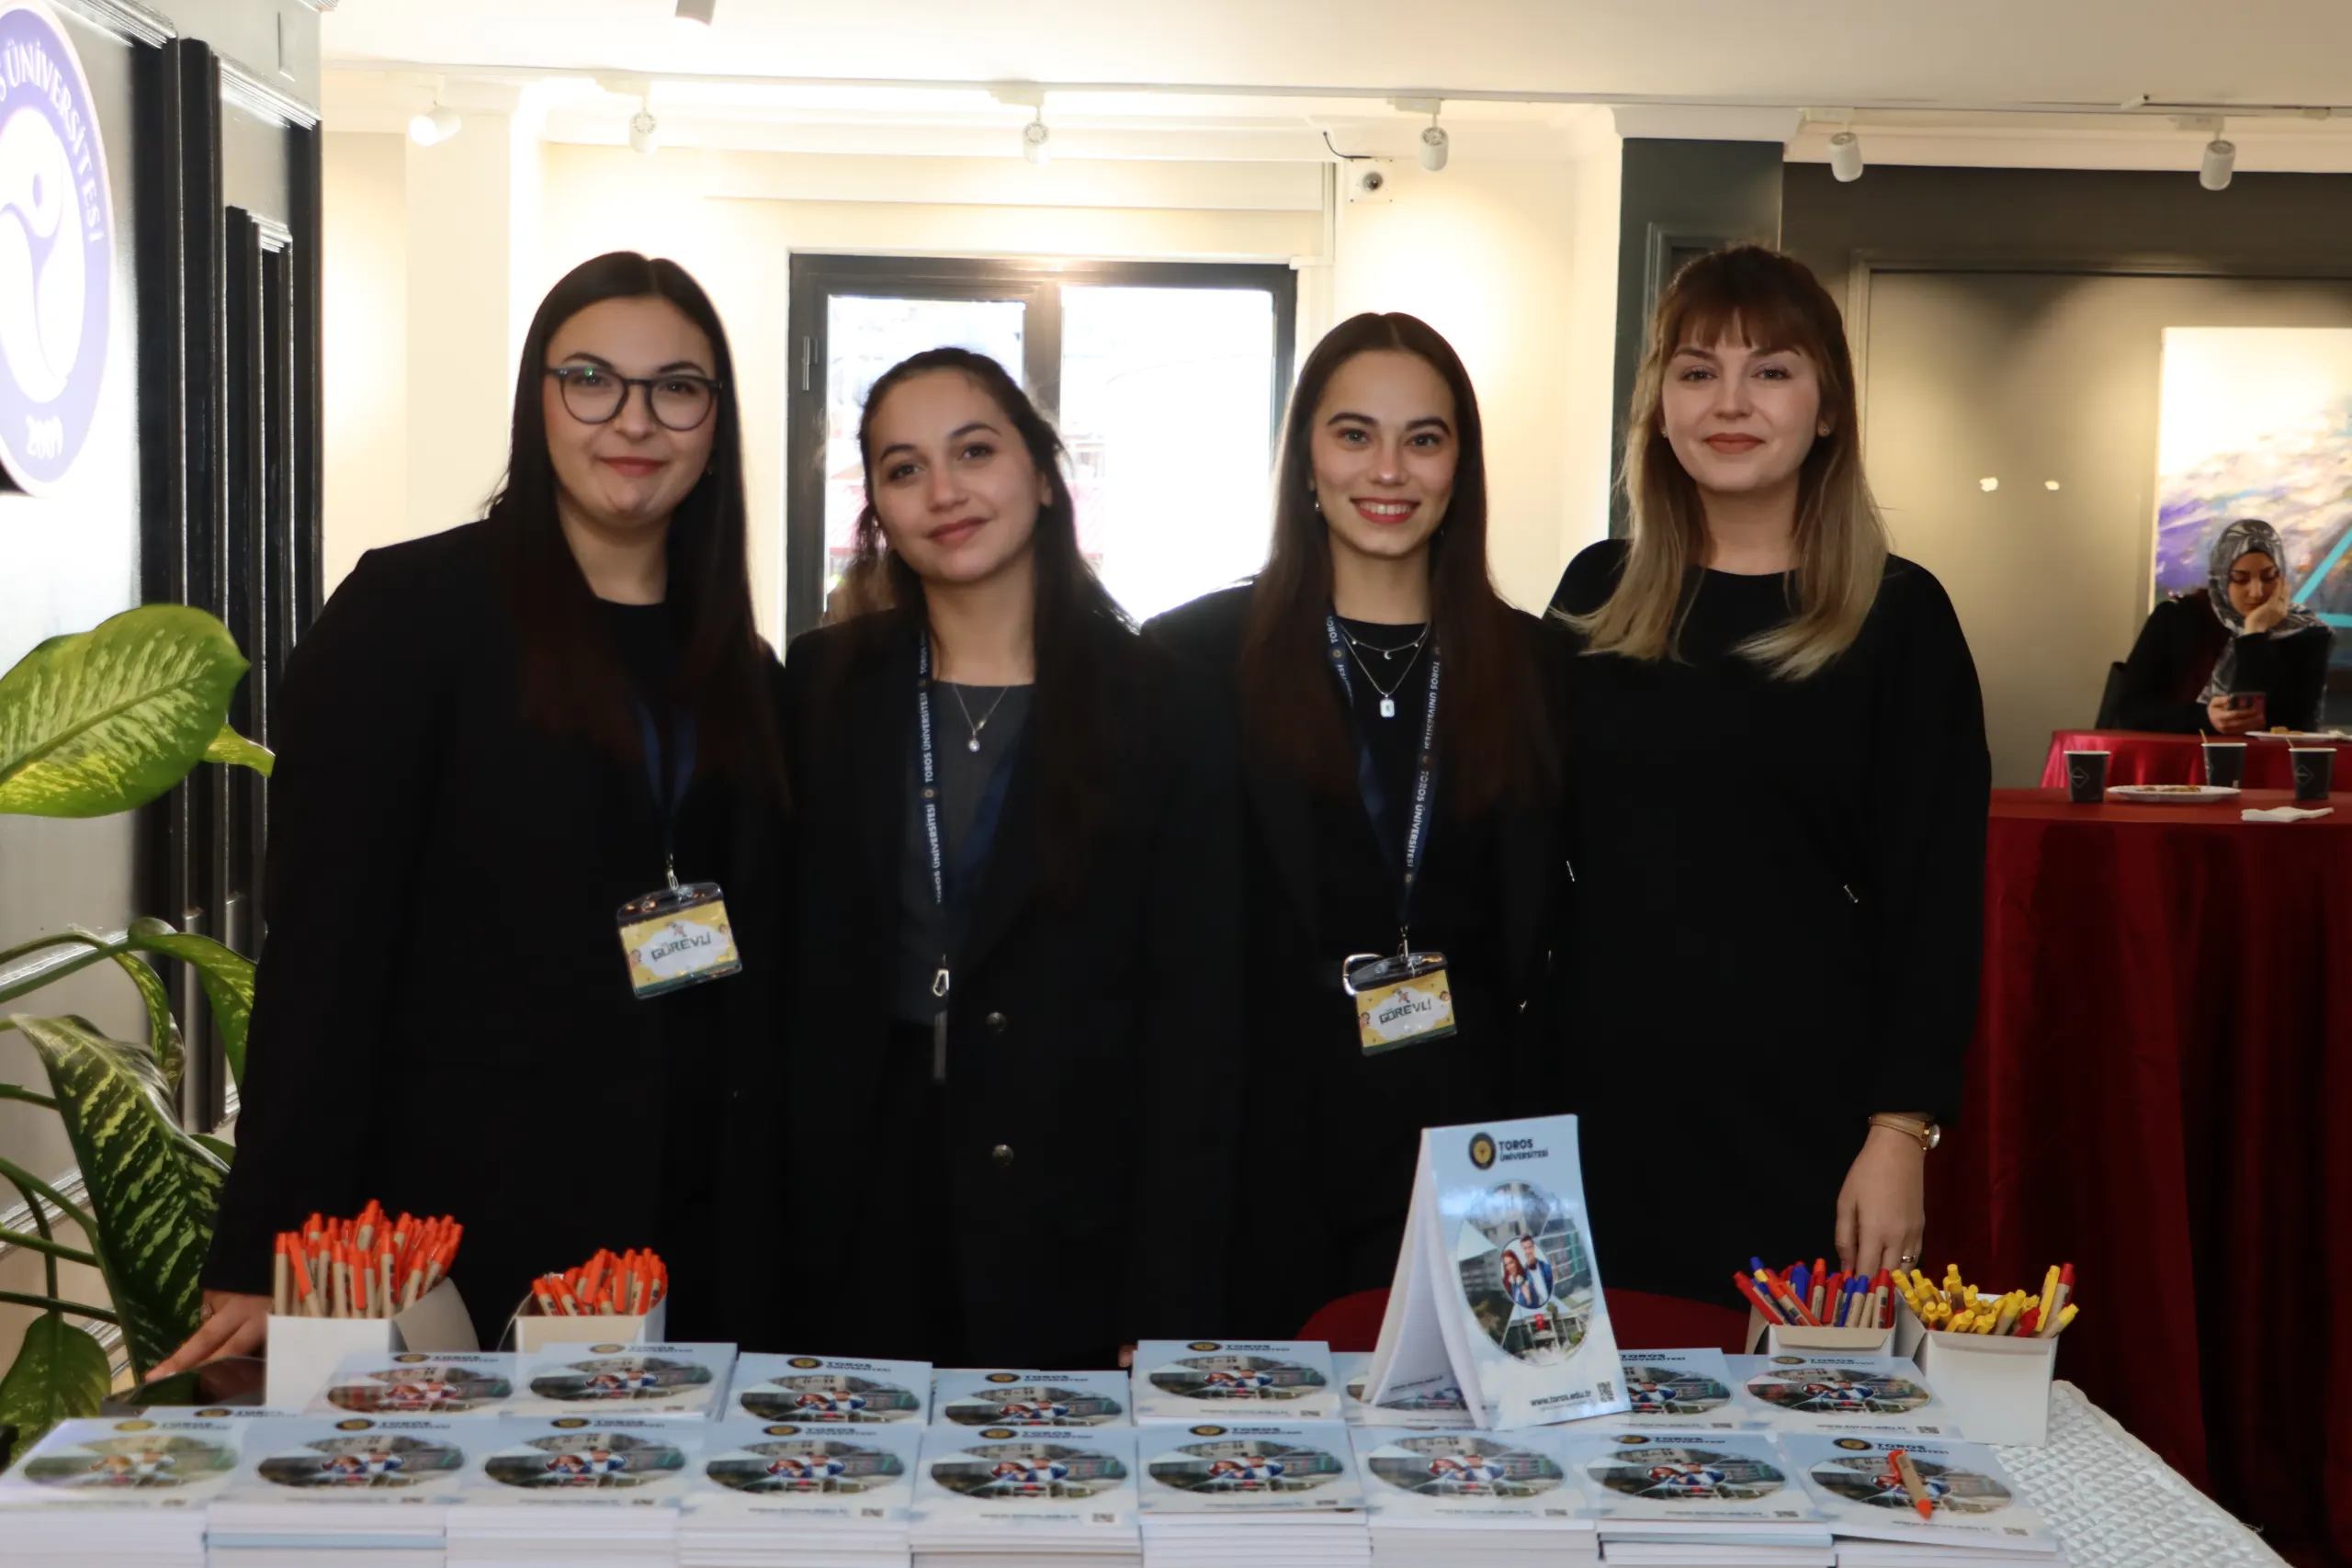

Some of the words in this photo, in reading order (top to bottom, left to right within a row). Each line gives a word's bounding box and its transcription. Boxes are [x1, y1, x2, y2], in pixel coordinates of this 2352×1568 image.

[6, 38, 105, 242] ÜNİVERSİTESİ
[1429, 660, 1441, 691] TOROS
[918, 693, 932, 751] ÜNİVERSİTESİ
[923, 753, 933, 783] TOROS
[1417, 770, 1430, 802] TOROS
[925, 804, 941, 869] ÜNİVERSİTESİ
[1406, 803, 1426, 868] ÜNİVERSİTESİ
[1498, 1138, 1533, 1152] TOROS
[1499, 1146, 1549, 1162] ÜNİVERSİTESİ
[1530, 1390, 1592, 1407] www.toros.edu.tr
